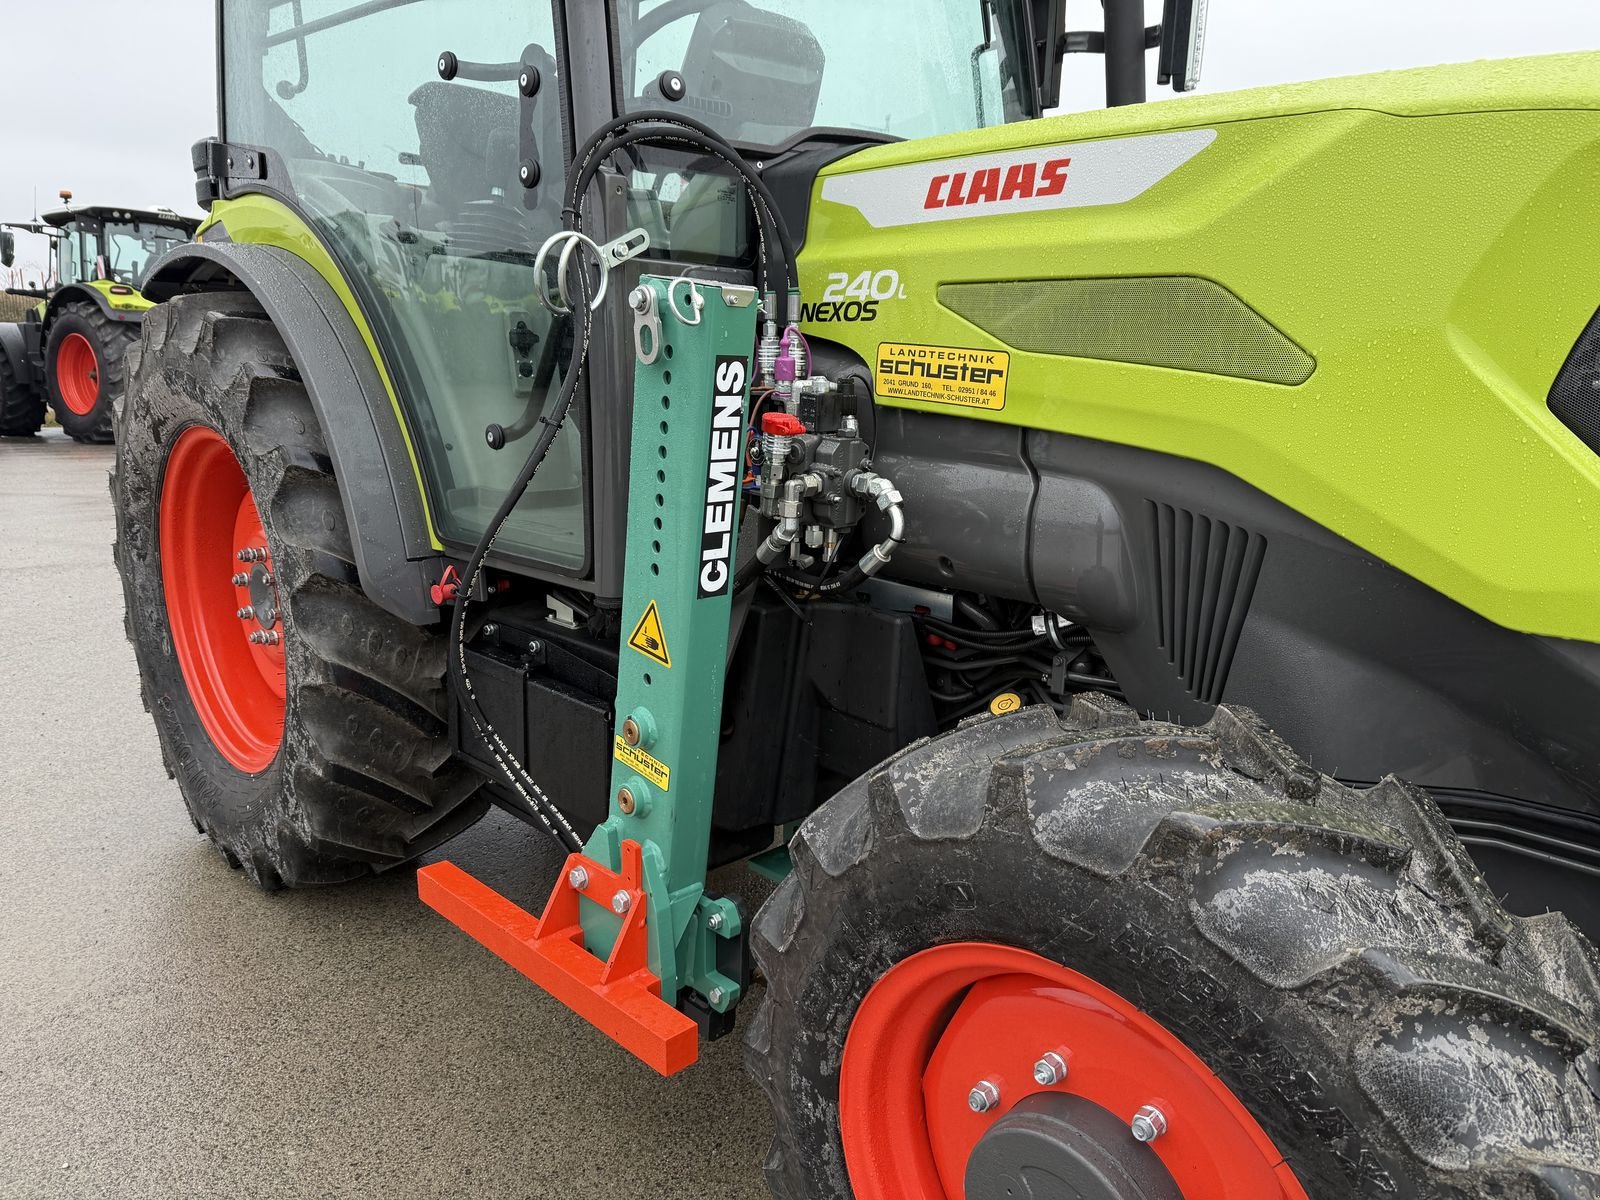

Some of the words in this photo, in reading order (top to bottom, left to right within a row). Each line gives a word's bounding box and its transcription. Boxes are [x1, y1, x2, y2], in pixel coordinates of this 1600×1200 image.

[923, 157, 1071, 210] CLAAS
[800, 300, 879, 322] NEXOS
[889, 347, 995, 364] LANDTECHNIK
[879, 358, 1004, 384] schuster
[883, 378, 896, 386] 2041
[897, 379, 919, 388] GRUND
[942, 384, 956, 392] TEL.
[957, 386, 975, 395] 02951
[887, 387, 991, 406] WWW.LANDTECHNIK-SCHUSTER.AT
[700, 360, 746, 593] CLEMENS
